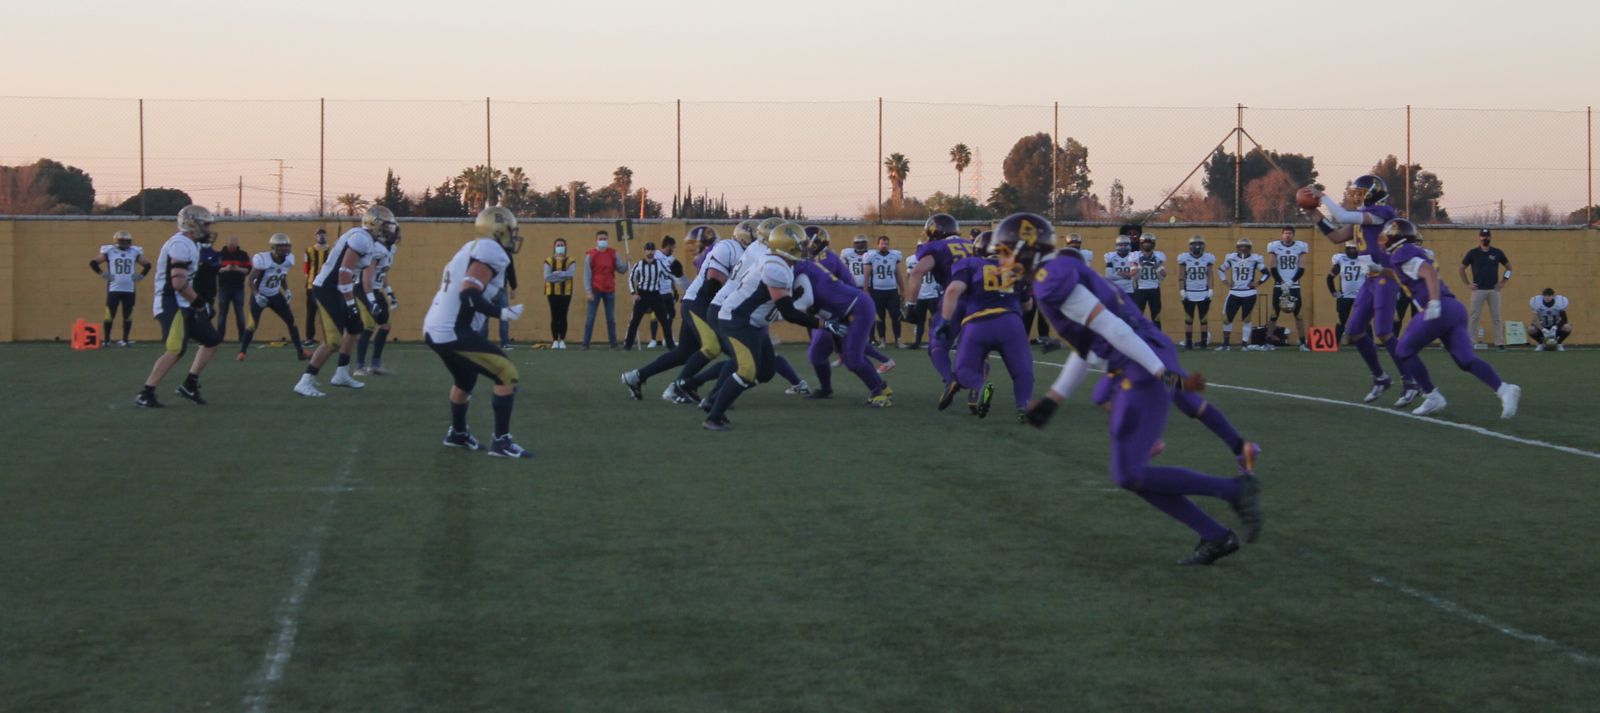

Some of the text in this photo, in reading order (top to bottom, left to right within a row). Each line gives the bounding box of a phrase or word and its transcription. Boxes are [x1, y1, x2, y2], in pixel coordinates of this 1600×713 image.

[114, 258, 132, 275] 66
[1280, 255, 1297, 270] 88
[877, 265, 894, 280] 94
[1234, 266, 1250, 281] 15
[1344, 266, 1361, 282] 57
[1313, 329, 1334, 349] 20
